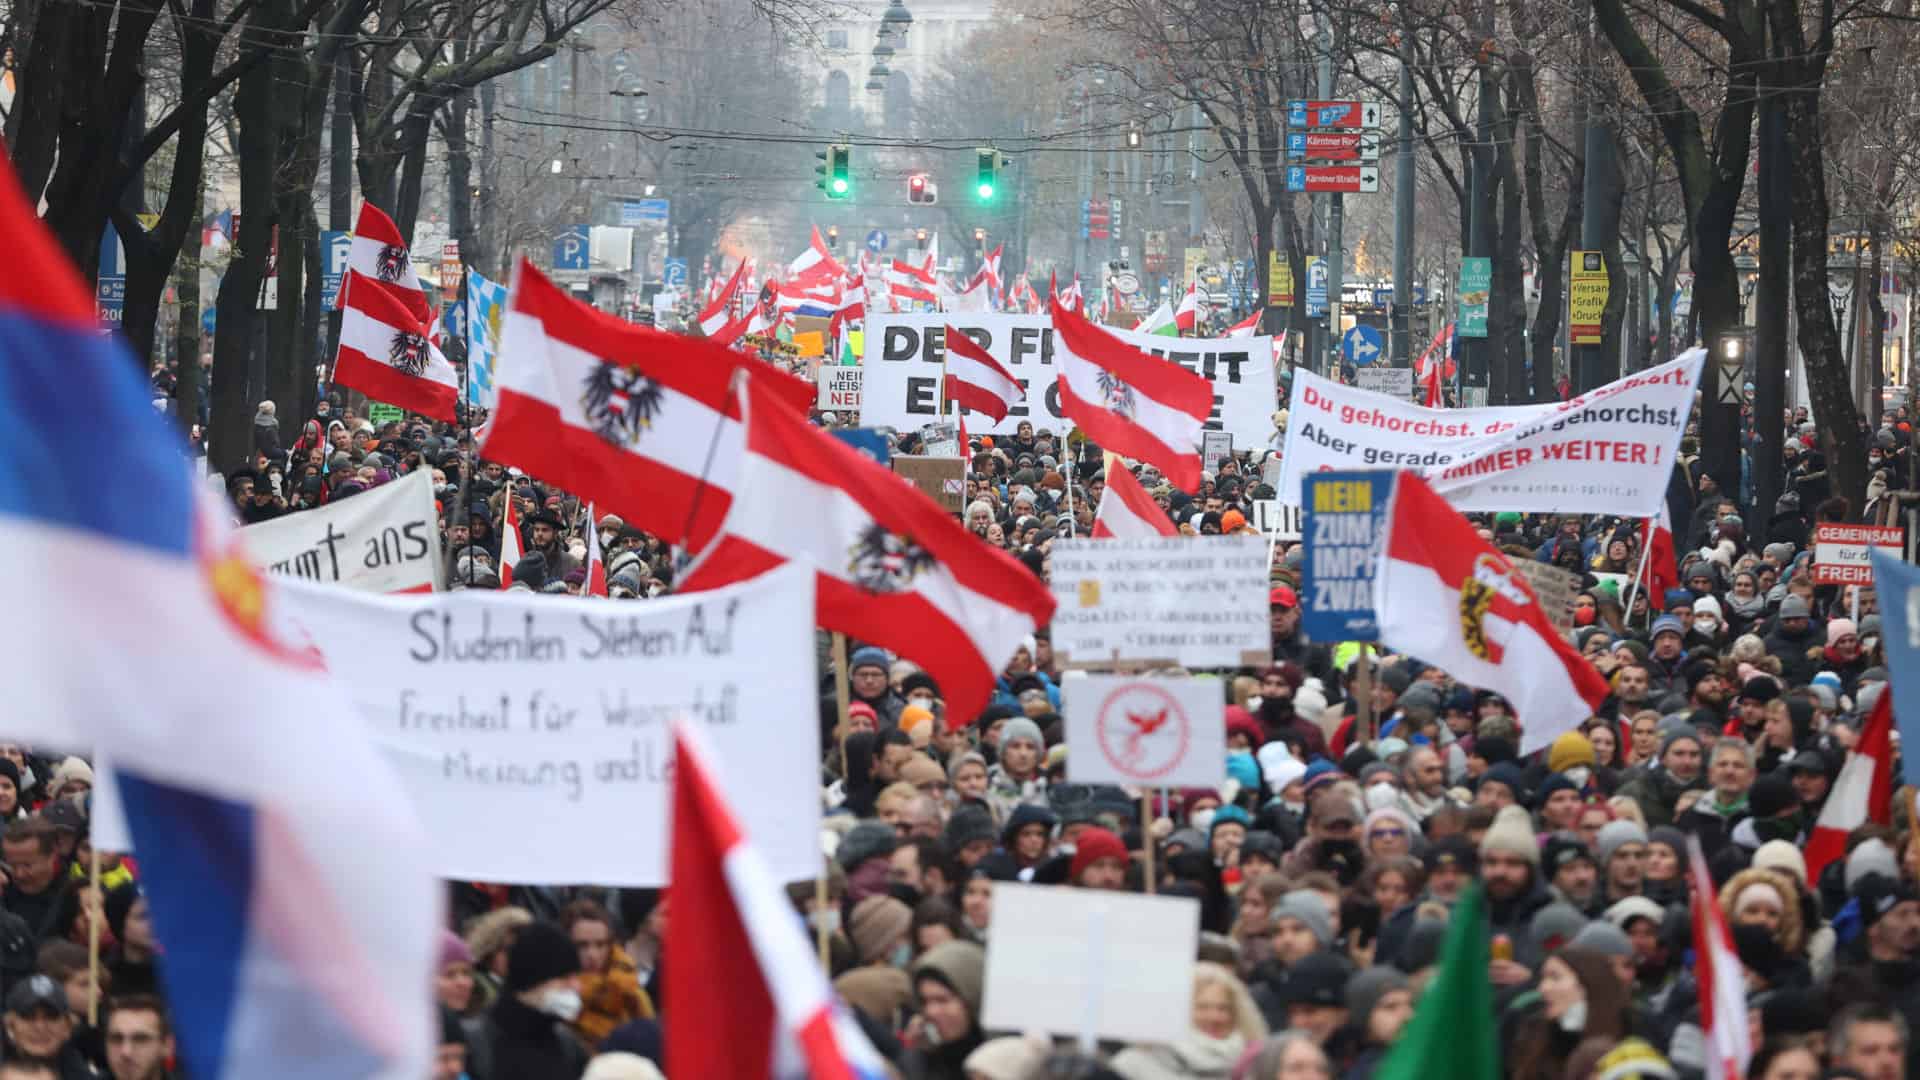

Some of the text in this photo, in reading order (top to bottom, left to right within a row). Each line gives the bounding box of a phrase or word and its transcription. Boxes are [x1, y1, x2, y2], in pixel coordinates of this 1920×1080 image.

[1577, 296, 1604, 306] Grafik
[829, 382, 863, 391] HEIS
[1303, 387, 1332, 413] Du
[1301, 422, 1357, 455] Aber
[1363, 447, 1452, 465] gerade
[1541, 440, 1648, 464] WEITER
[1314, 480, 1372, 512] NEIN
[1313, 514, 1372, 545] ZUM
[1819, 527, 1902, 543] GEMEINSAM
[364, 520, 428, 568] ans
[1839, 549, 1855, 559] für
[1819, 566, 1873, 582] FREIH
[1313, 581, 1374, 611] ZWA
[409, 608, 566, 662] Studenten
[529, 689, 578, 731] für
